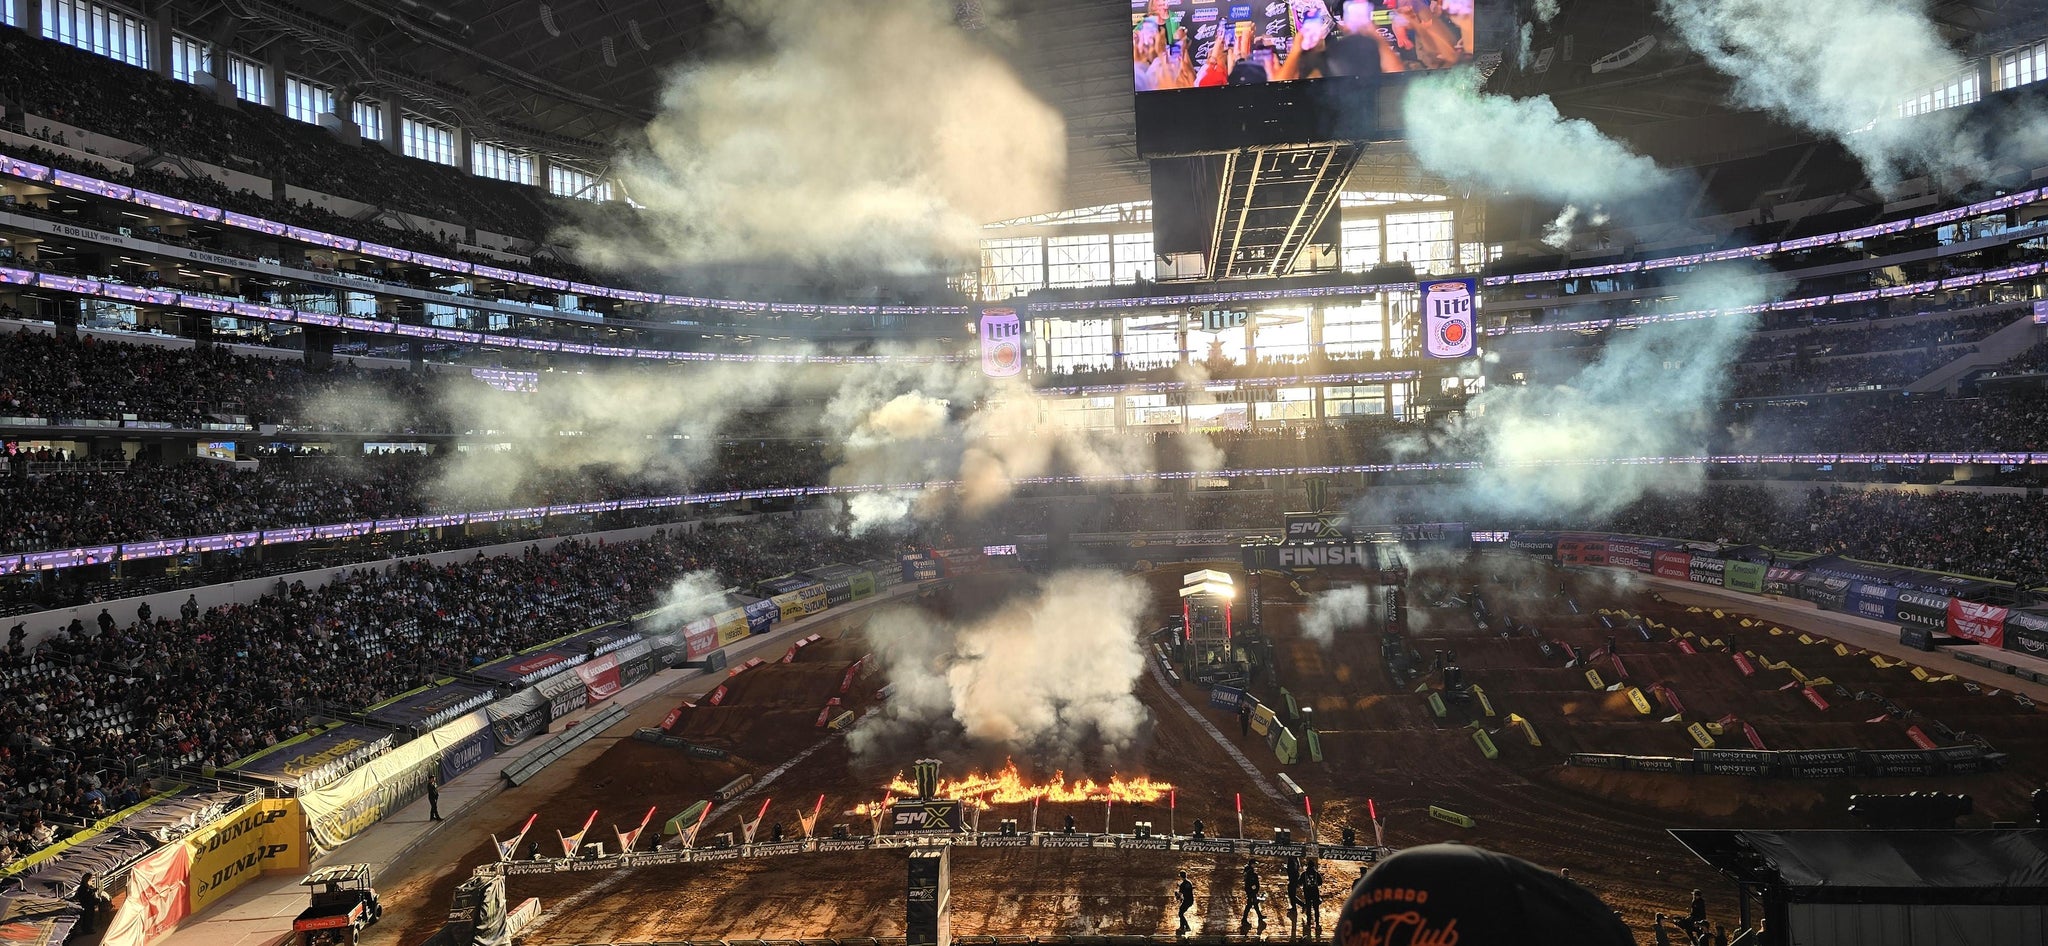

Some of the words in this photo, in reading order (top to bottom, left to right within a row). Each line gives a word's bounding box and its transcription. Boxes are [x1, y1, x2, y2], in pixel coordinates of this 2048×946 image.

[52, 224, 62, 233] 74
[65, 226, 80, 237] BOB
[81, 229, 99, 240] LILLY
[199, 253, 213, 262] DON
[213, 255, 237, 267] PERKINS
[1434, 299, 1468, 319] Lite
[1201, 310, 1247, 334] Lite
[987, 322, 1018, 342] Lite
[1289, 517, 1345, 537] SMX
[1517, 541, 1553, 550] Husqvarna
[1609, 544, 1640, 555] GASGAS
[1280, 545, 1362, 566] FINISH
[1609, 556, 1639, 567] GASGAS
[1665, 555, 1686, 564] HONDA
[1664, 568, 1685, 577] HONDA
[800, 584, 825, 600] SUZUKI
[1867, 585, 1887, 597] YAMAHA
[803, 598, 827, 613] SUZUKI
[1865, 602, 1885, 615] YAMAHA
[1912, 596, 1948, 609] OAKLEY
[751, 609, 779, 626] FALKEN
[1911, 613, 1945, 627] OAKLEY
[2020, 616, 2048, 629] TRIUMPH
[1954, 618, 1998, 638] FLY
[2018, 637, 2046, 651] TRIUMPH
[590, 660, 614, 676] HONDA
[1217, 691, 1238, 703] YAMAHA
[666, 712, 676, 726] FLY
[1692, 726, 1709, 746] SUZUKI
[460, 741, 482, 764] YAMAHA
[1639, 760, 1673, 768] MONSTER
[895, 807, 951, 828] SMX
[1432, 810, 1463, 825] Kawasaki
[209, 810, 287, 852] DUNLOP
[211, 844, 288, 890] DUNLOP
[909, 889, 935, 899] SMX
[1353, 888, 1428, 912] COLORADO
[1383, 911, 1459, 946] Club
